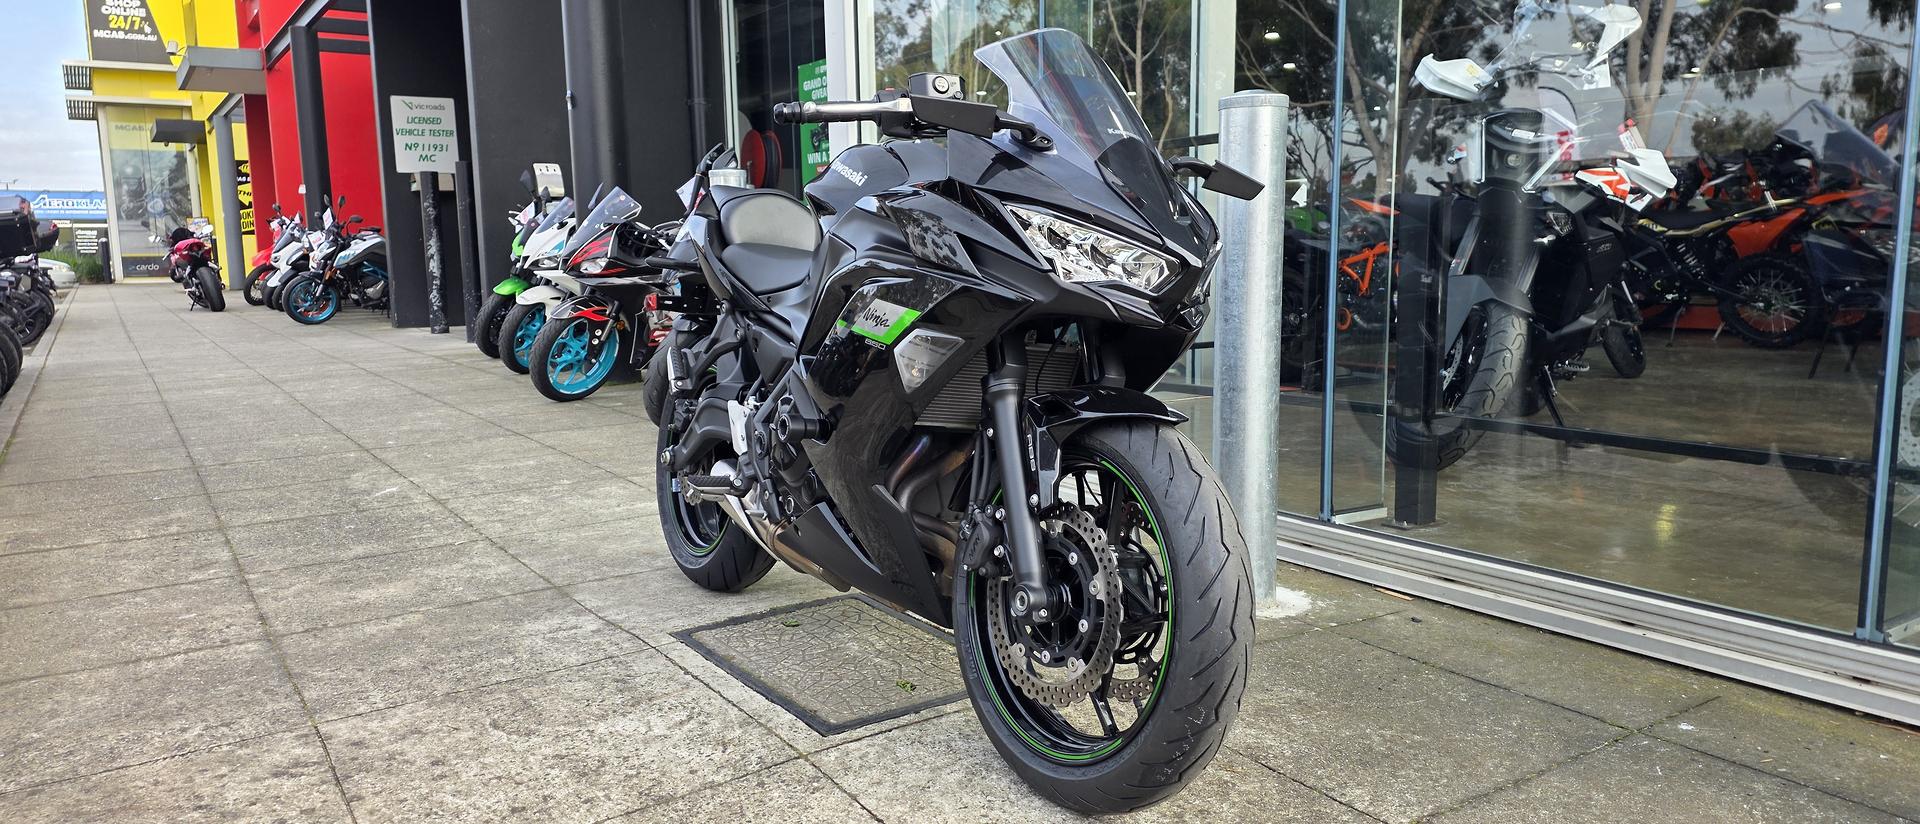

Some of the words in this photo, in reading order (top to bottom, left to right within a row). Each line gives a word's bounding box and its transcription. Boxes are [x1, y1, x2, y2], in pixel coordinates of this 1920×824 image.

[105, 0, 141, 8] SHOP
[101, 5, 146, 17] ONLINE
[108, 15, 141, 30] 24/7
[93, 29, 158, 41] MCAS.COM.AU
[803, 77, 821, 91] GRAND
[406, 116, 442, 125] LICENSED
[395, 128, 426, 137] VEHICLE
[428, 129, 455, 137] TESTER
[418, 153, 437, 163] MC
[807, 152, 821, 164] WIN
[822, 151, 828, 162] A
[135, 263, 160, 271] cardo
[862, 307, 890, 329] Ninja
[864, 338, 887, 351] 650
